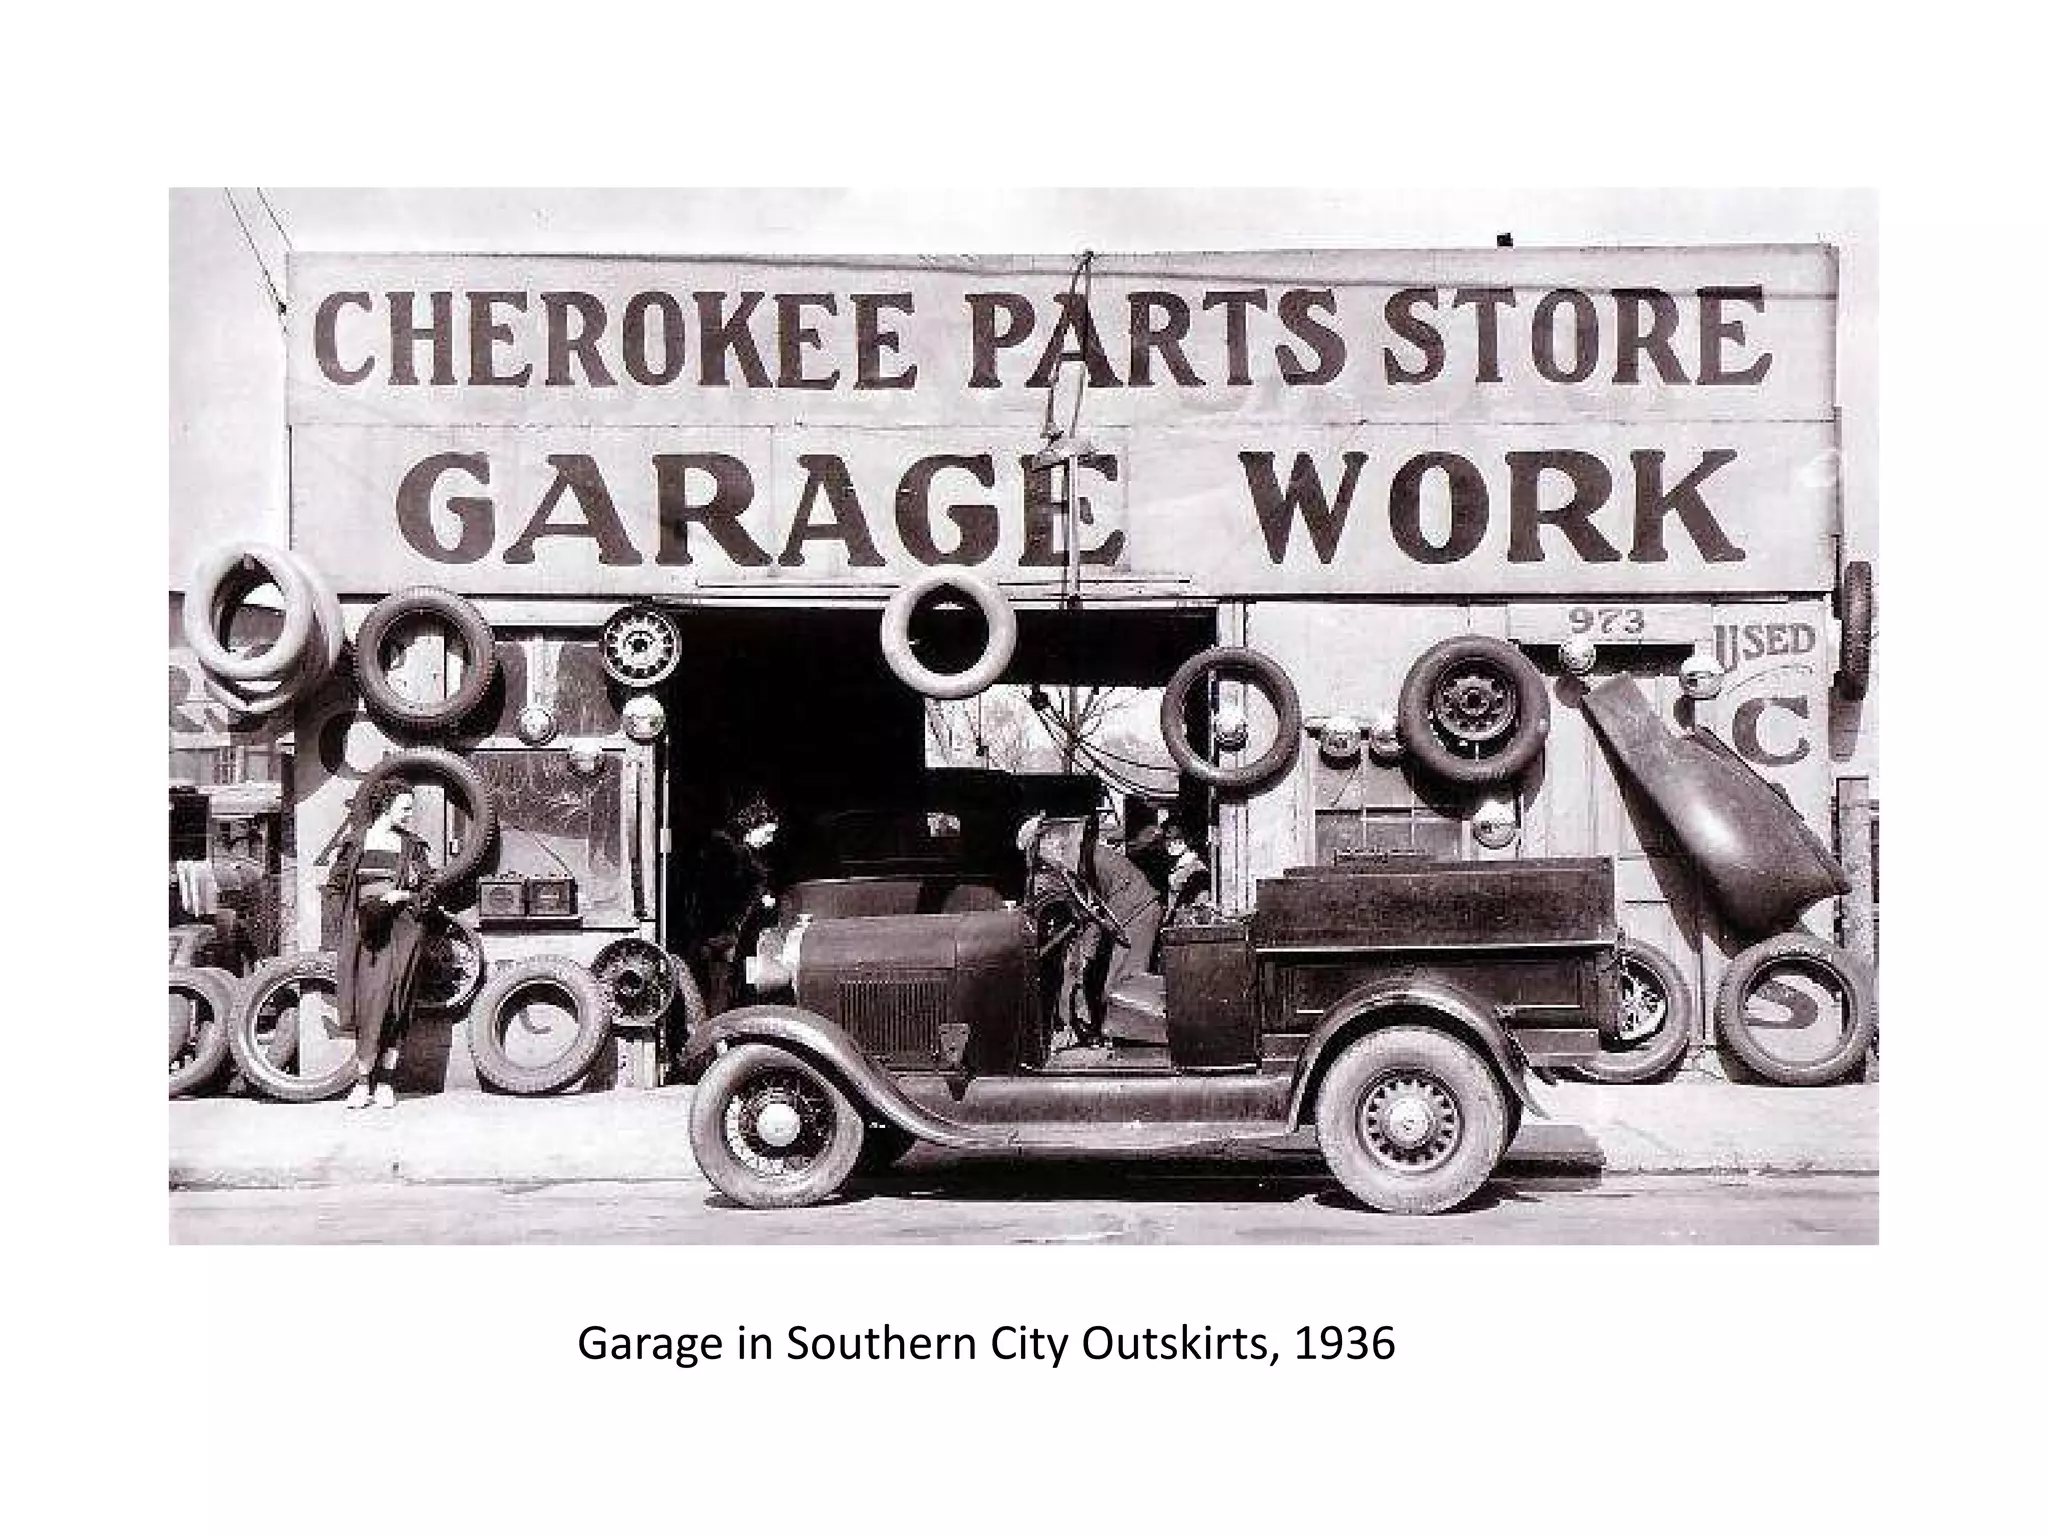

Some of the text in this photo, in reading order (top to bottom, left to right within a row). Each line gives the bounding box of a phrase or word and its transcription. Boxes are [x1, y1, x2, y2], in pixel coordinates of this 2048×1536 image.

[314, 286, 1773, 391] CHEROKEE PARTS STORE
[395, 449, 1747, 568] GARAGE WORK
[1568, 607, 1645, 634] 973
[1713, 621, 1816, 673] USED
